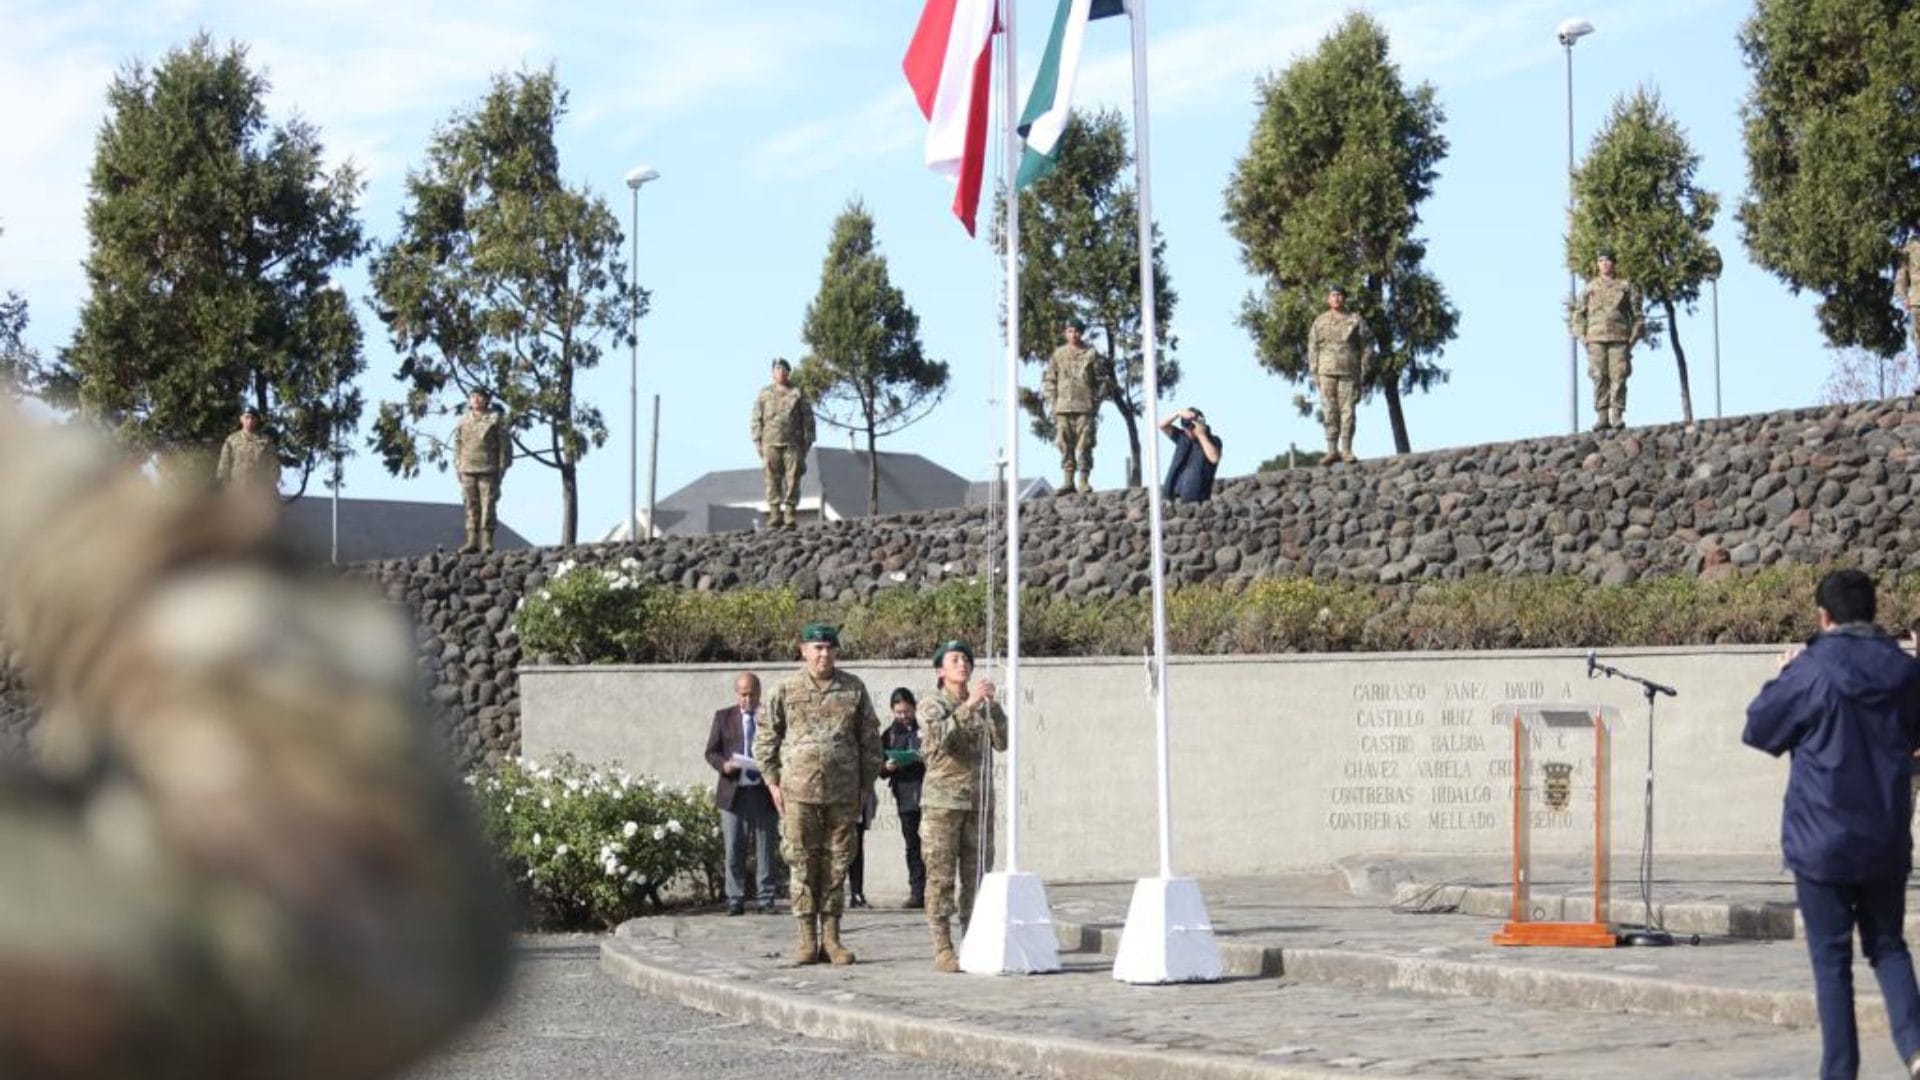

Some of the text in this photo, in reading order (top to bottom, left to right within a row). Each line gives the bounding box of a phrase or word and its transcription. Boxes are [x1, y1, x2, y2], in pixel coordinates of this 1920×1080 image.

[1353, 682, 1426, 702] CARRASCO
[1505, 680, 1544, 700] DAVID
[1561, 681, 1572, 699] A
[1357, 708, 1424, 727] CASTILLO
[1360, 735, 1414, 753] CASTRO
[1431, 734, 1486, 753] BALBOA
[1417, 759, 1472, 778] VARELA
[1331, 786, 1414, 804] CONTRERAS
[1431, 785, 1491, 804] HIDALGO
[1328, 811, 1411, 830] CONTRERAS
[1428, 811, 1495, 830] MELLADO
